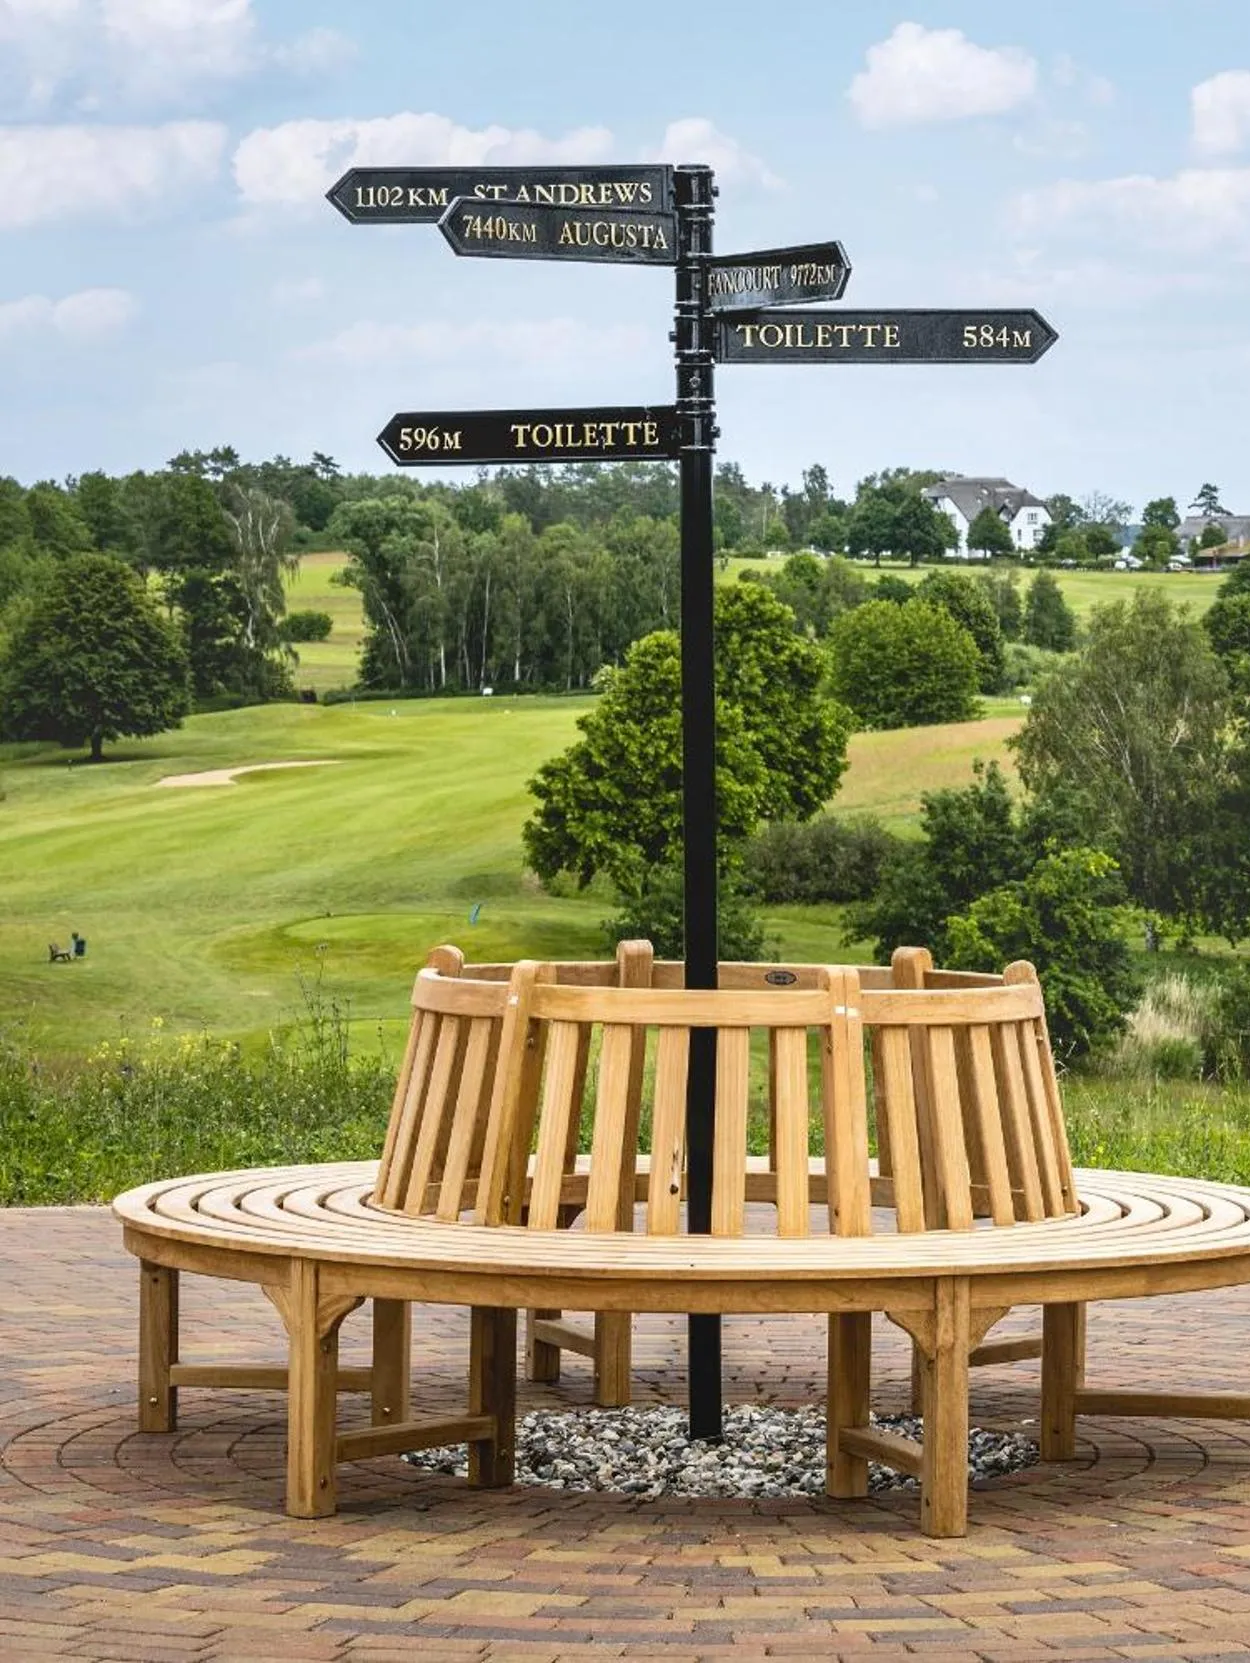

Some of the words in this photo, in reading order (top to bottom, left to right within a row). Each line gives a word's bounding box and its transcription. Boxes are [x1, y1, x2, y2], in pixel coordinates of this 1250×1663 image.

[515, 182, 653, 205] ANDREWS
[558, 221, 669, 250] AUGUSTA
[736, 323, 901, 349] TOILETTE
[961, 324, 1033, 349] 584M
[399, 427, 463, 450] 596M
[510, 421, 660, 449] TOILETTE
